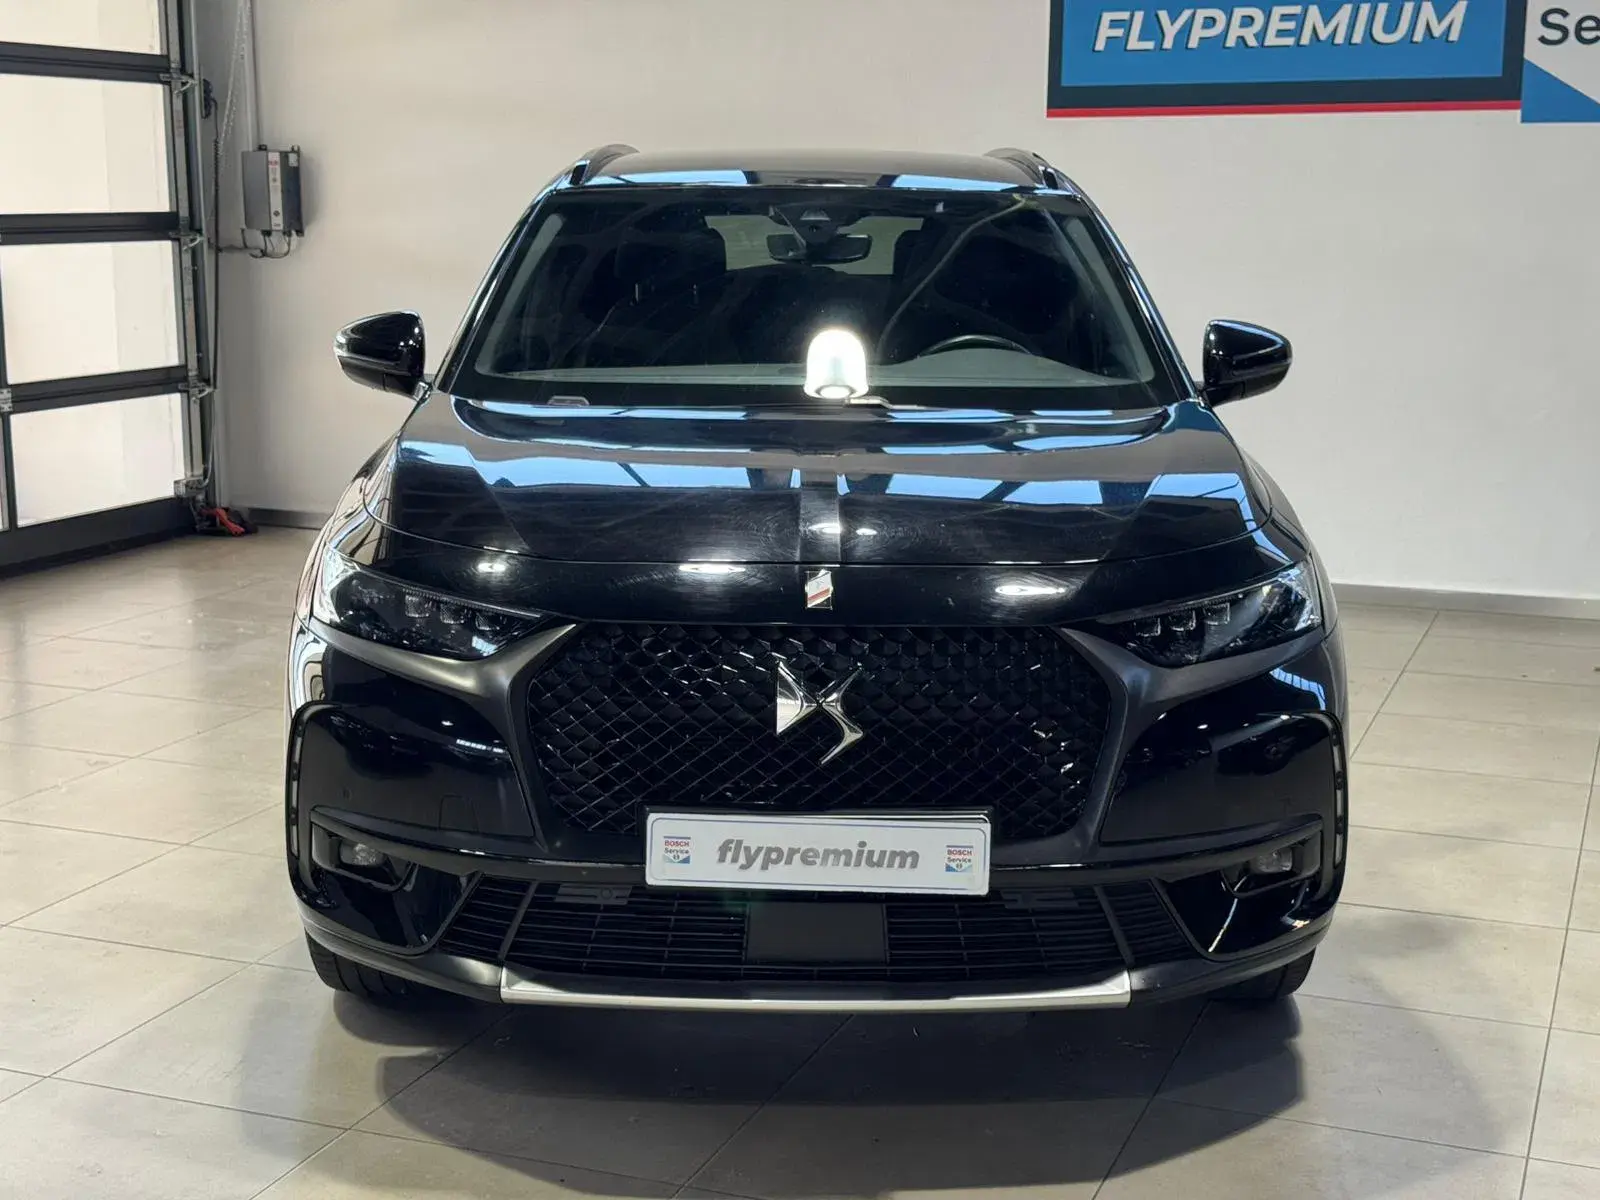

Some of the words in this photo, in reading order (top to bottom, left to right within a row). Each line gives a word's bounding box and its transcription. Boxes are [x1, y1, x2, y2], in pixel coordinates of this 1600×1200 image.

[1092, 0, 1467, 52] FLYPREMIUM
[1538, 8, 1600, 46] Se
[717, 838, 920, 870] flypremium
